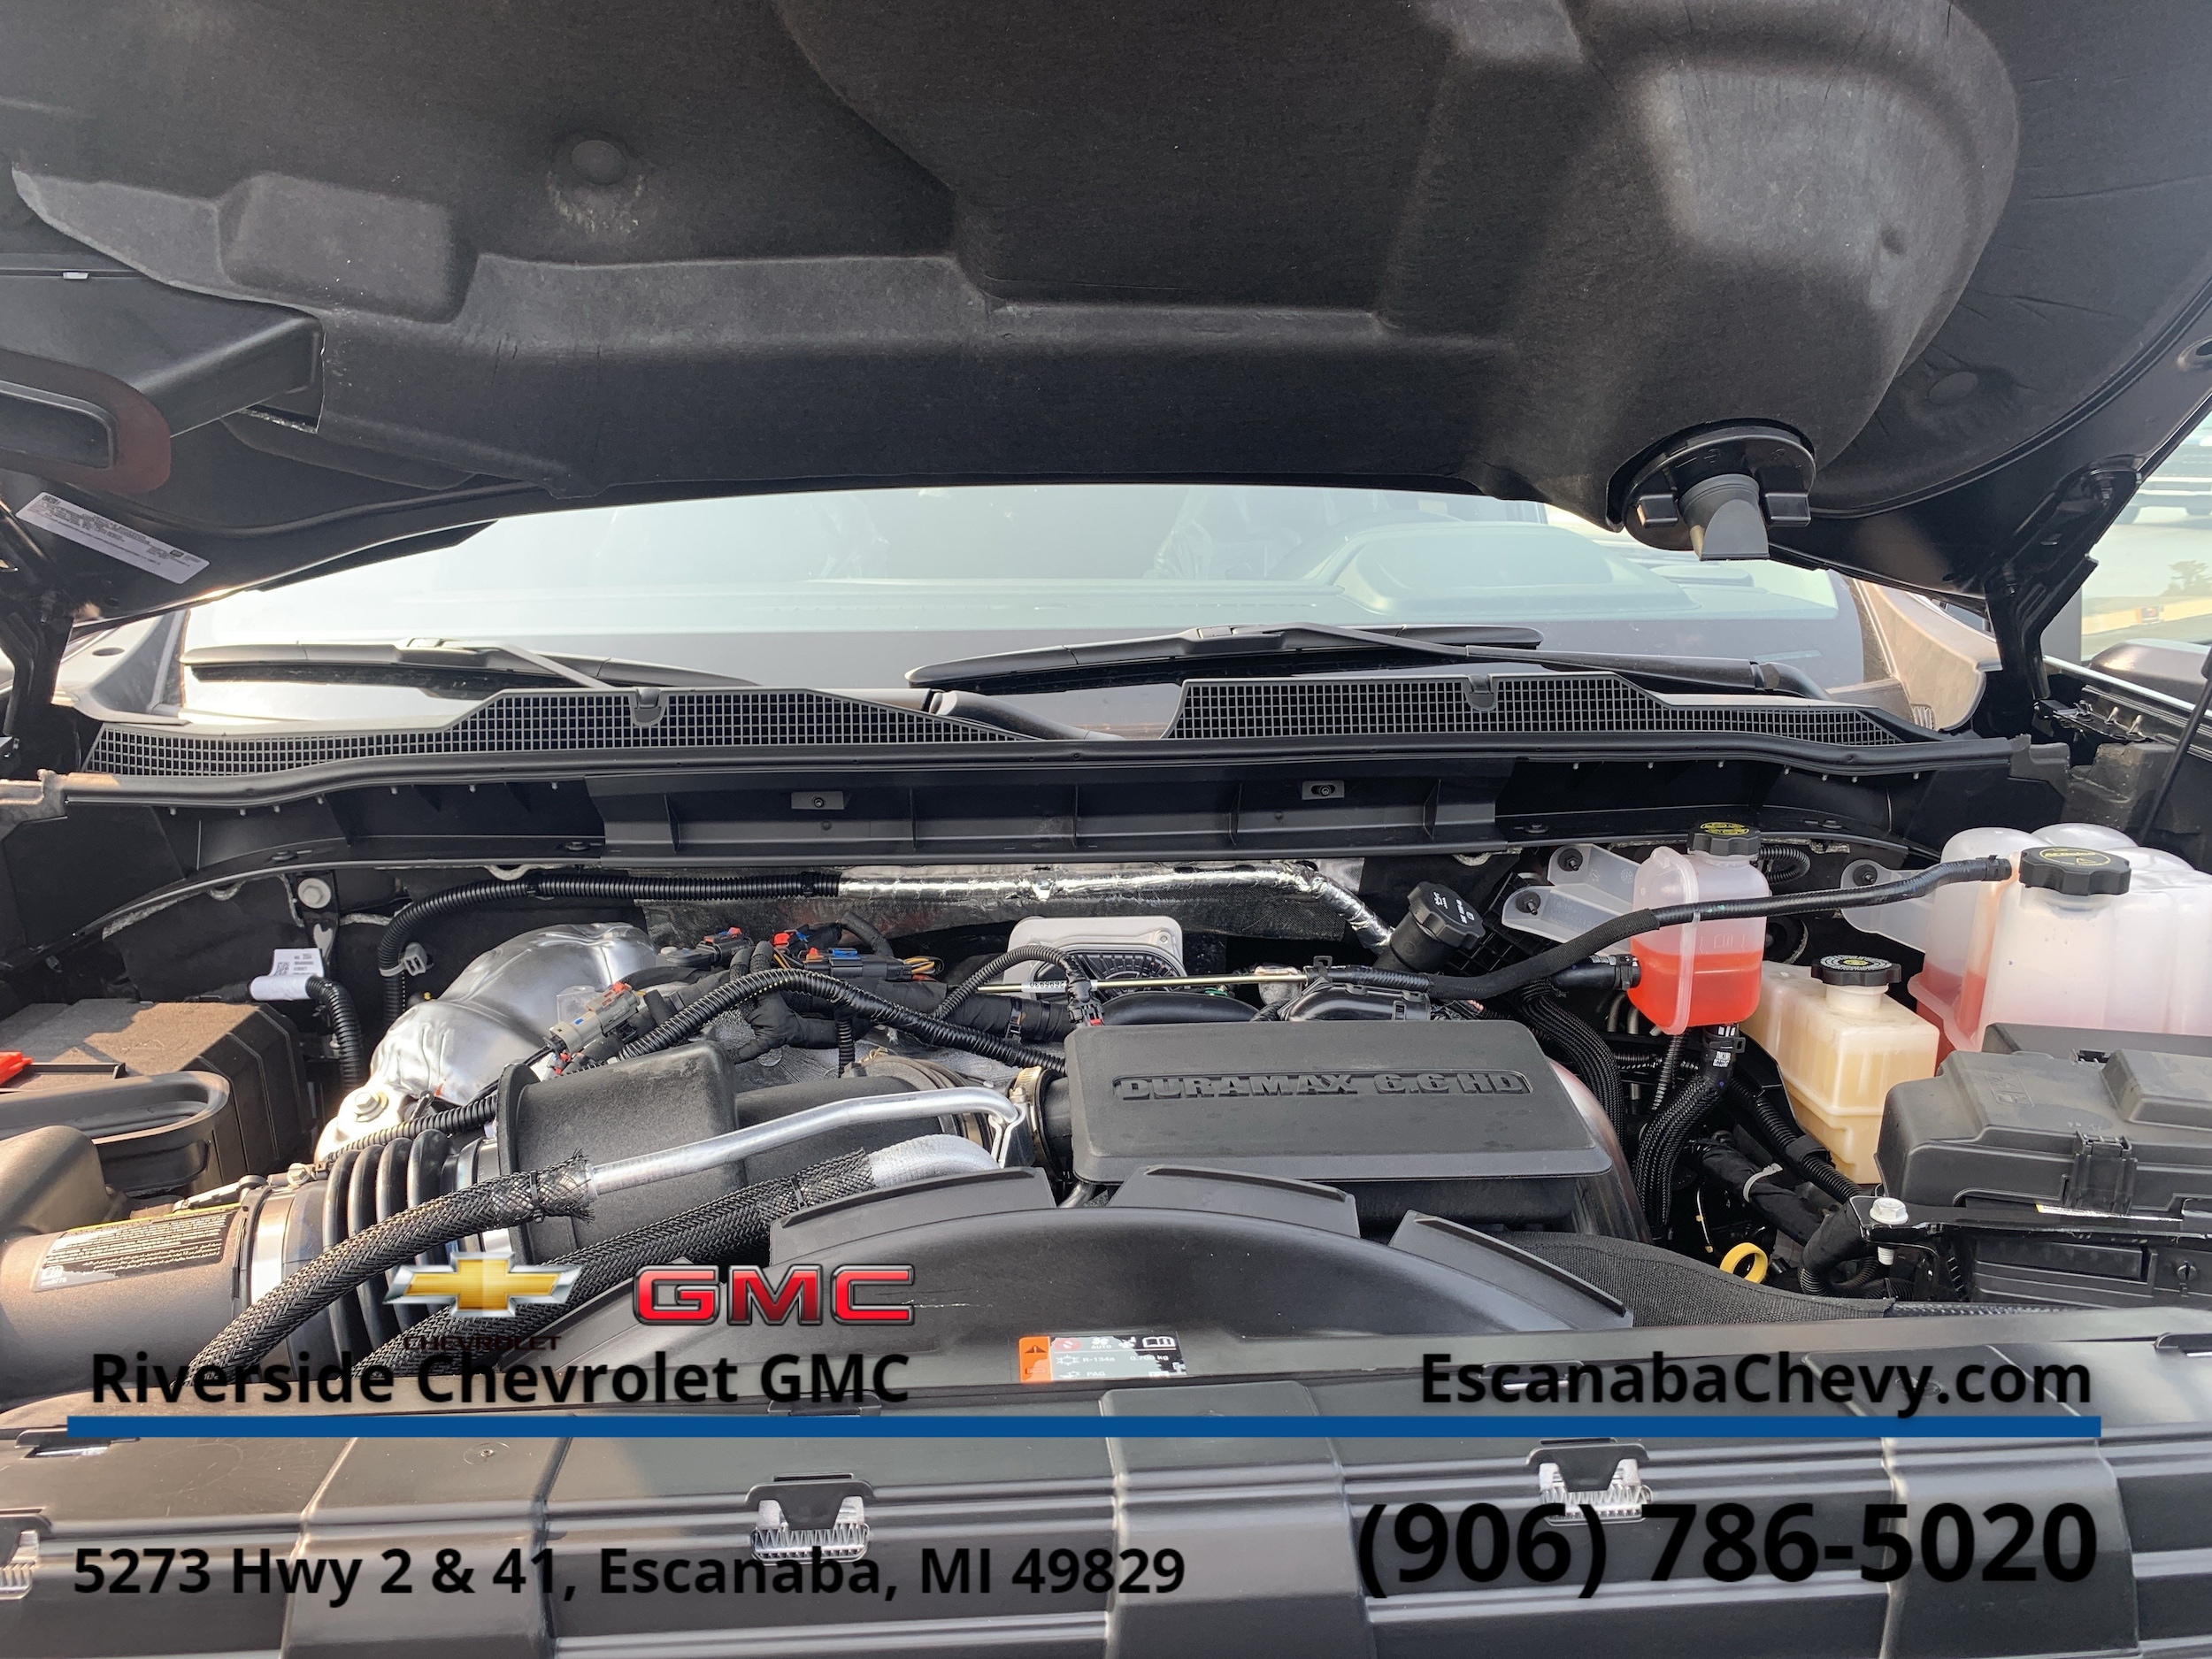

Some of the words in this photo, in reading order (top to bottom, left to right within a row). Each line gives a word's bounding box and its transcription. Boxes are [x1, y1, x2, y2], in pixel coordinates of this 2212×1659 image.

[1121, 1073, 1358, 1099] DURAMAX
[1373, 1073, 1451, 1094] 6.6
[1456, 1073, 1525, 1094] HD
